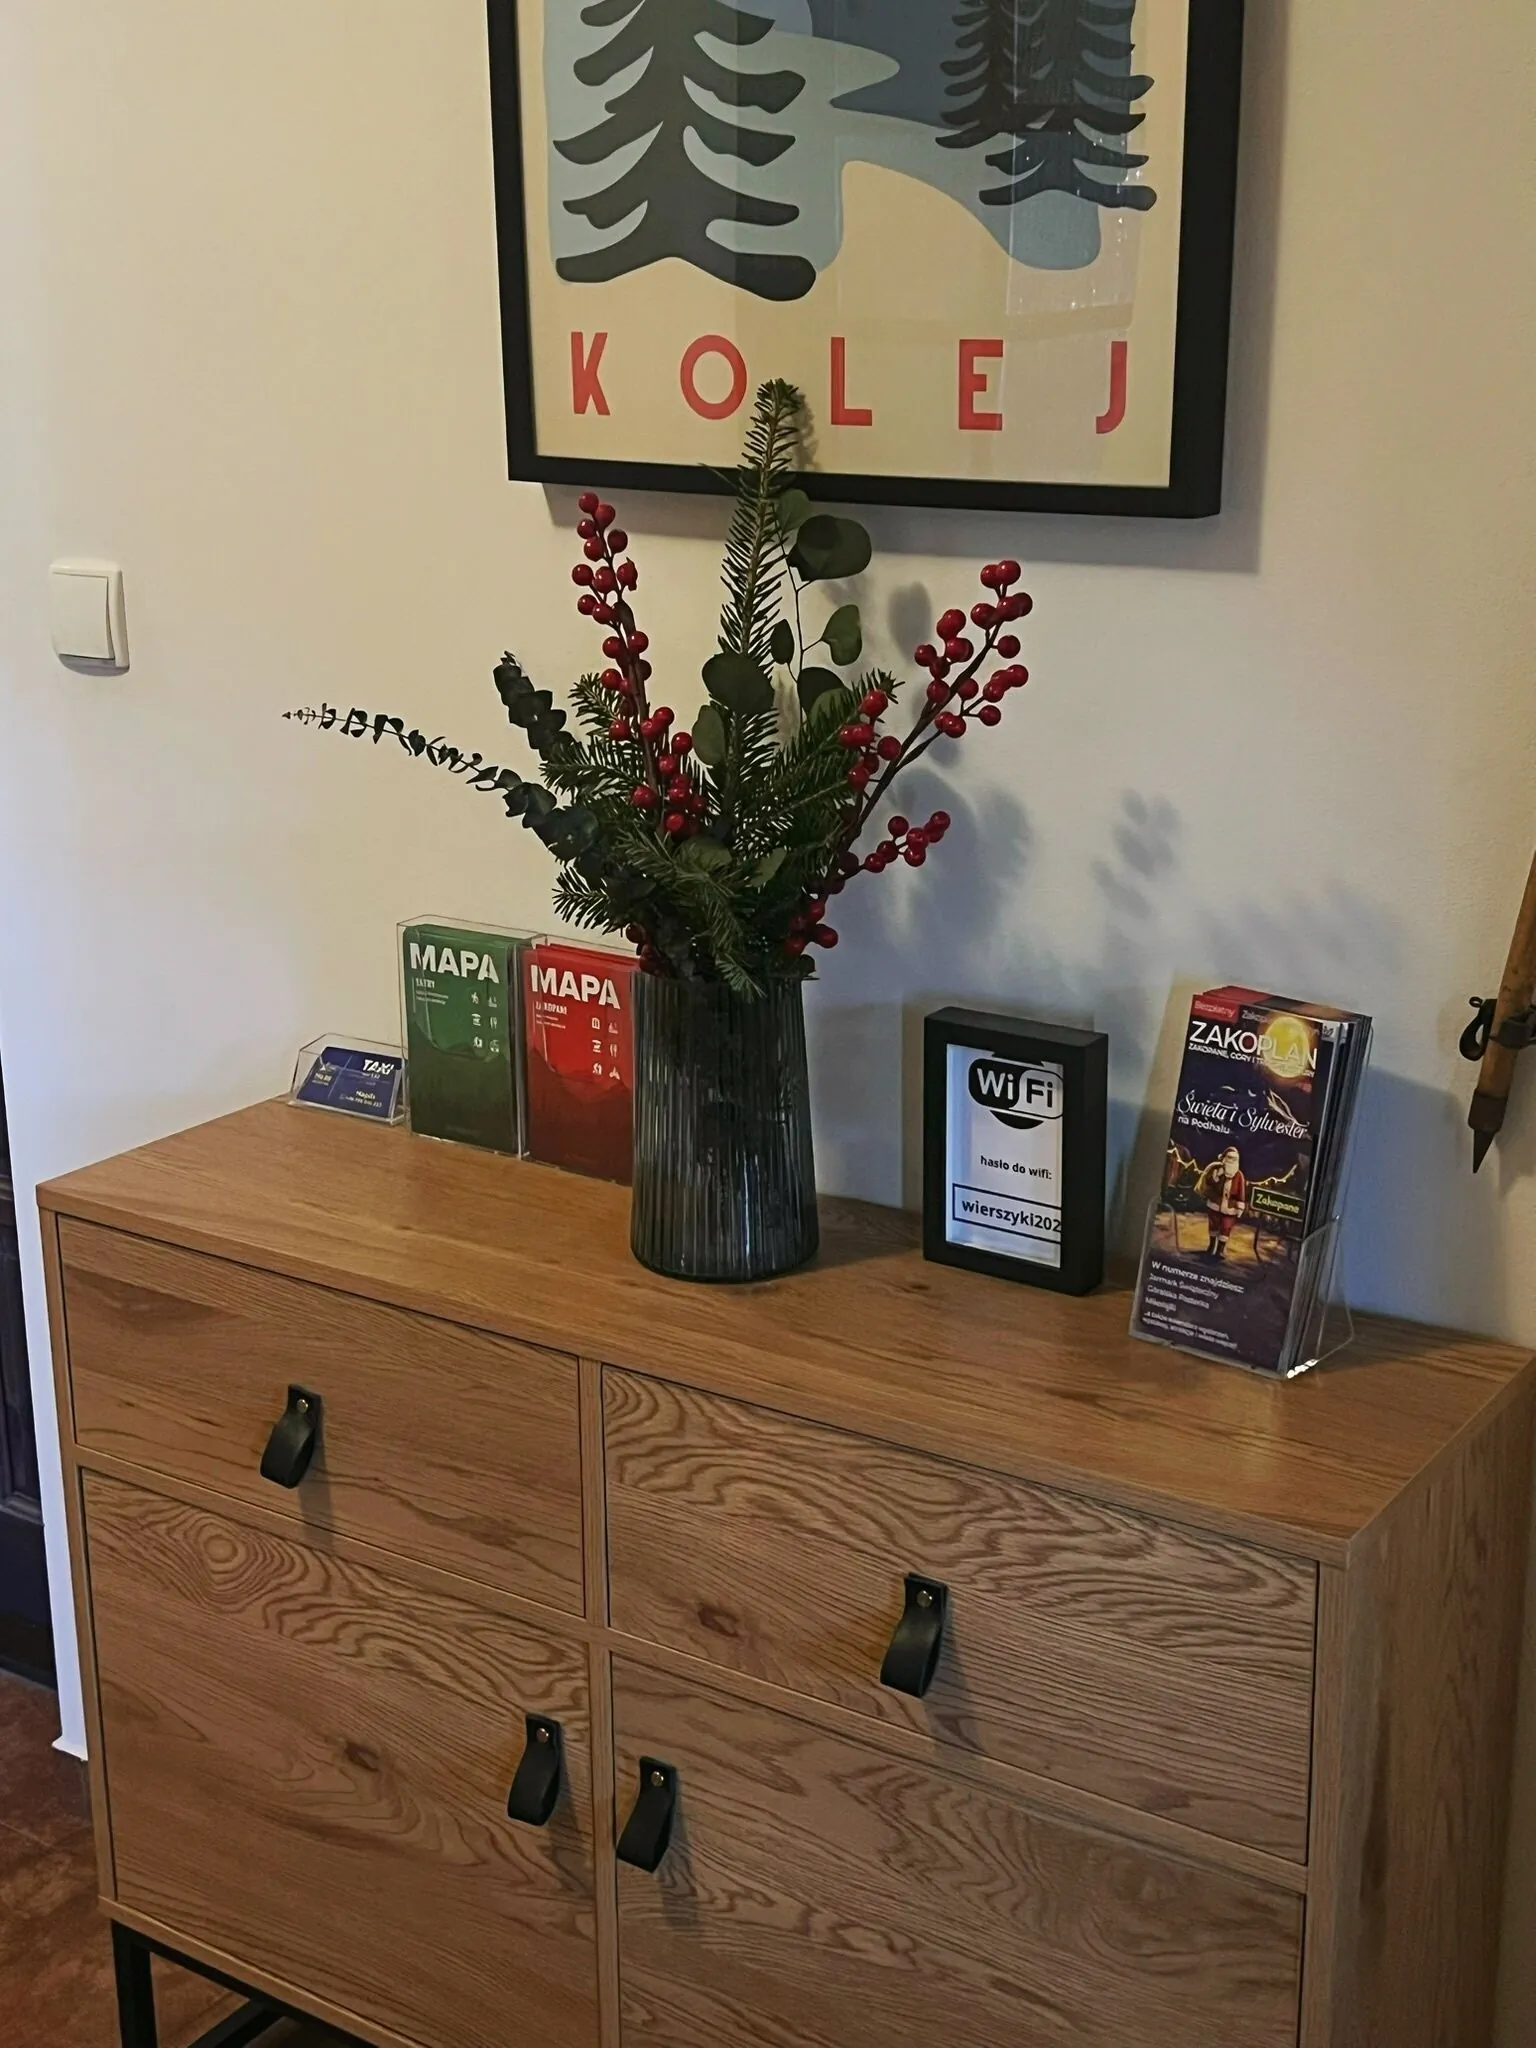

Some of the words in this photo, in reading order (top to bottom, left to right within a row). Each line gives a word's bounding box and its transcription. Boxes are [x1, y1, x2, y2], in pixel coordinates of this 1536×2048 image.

[570, 331, 1128, 434] KOLEJ
[409, 942, 500, 984] MAPA
[530, 964, 621, 1010] MAPA
[1189, 1020, 1318, 1070] ZAKOPLAN
[362, 1059, 394, 1076] TAXI
[976, 1067, 1054, 1108] WiFi
[1178, 1115, 1189, 1125] na
[1191, 1117, 1231, 1135] Podhalu
[1238, 1107, 1310, 1139] Sylwester
[1011, 1162, 1026, 1174] do
[1028, 1167, 1052, 1180] wifi:
[1151, 1260, 1161, 1270] W
[1161, 1264, 1199, 1281] numerze
